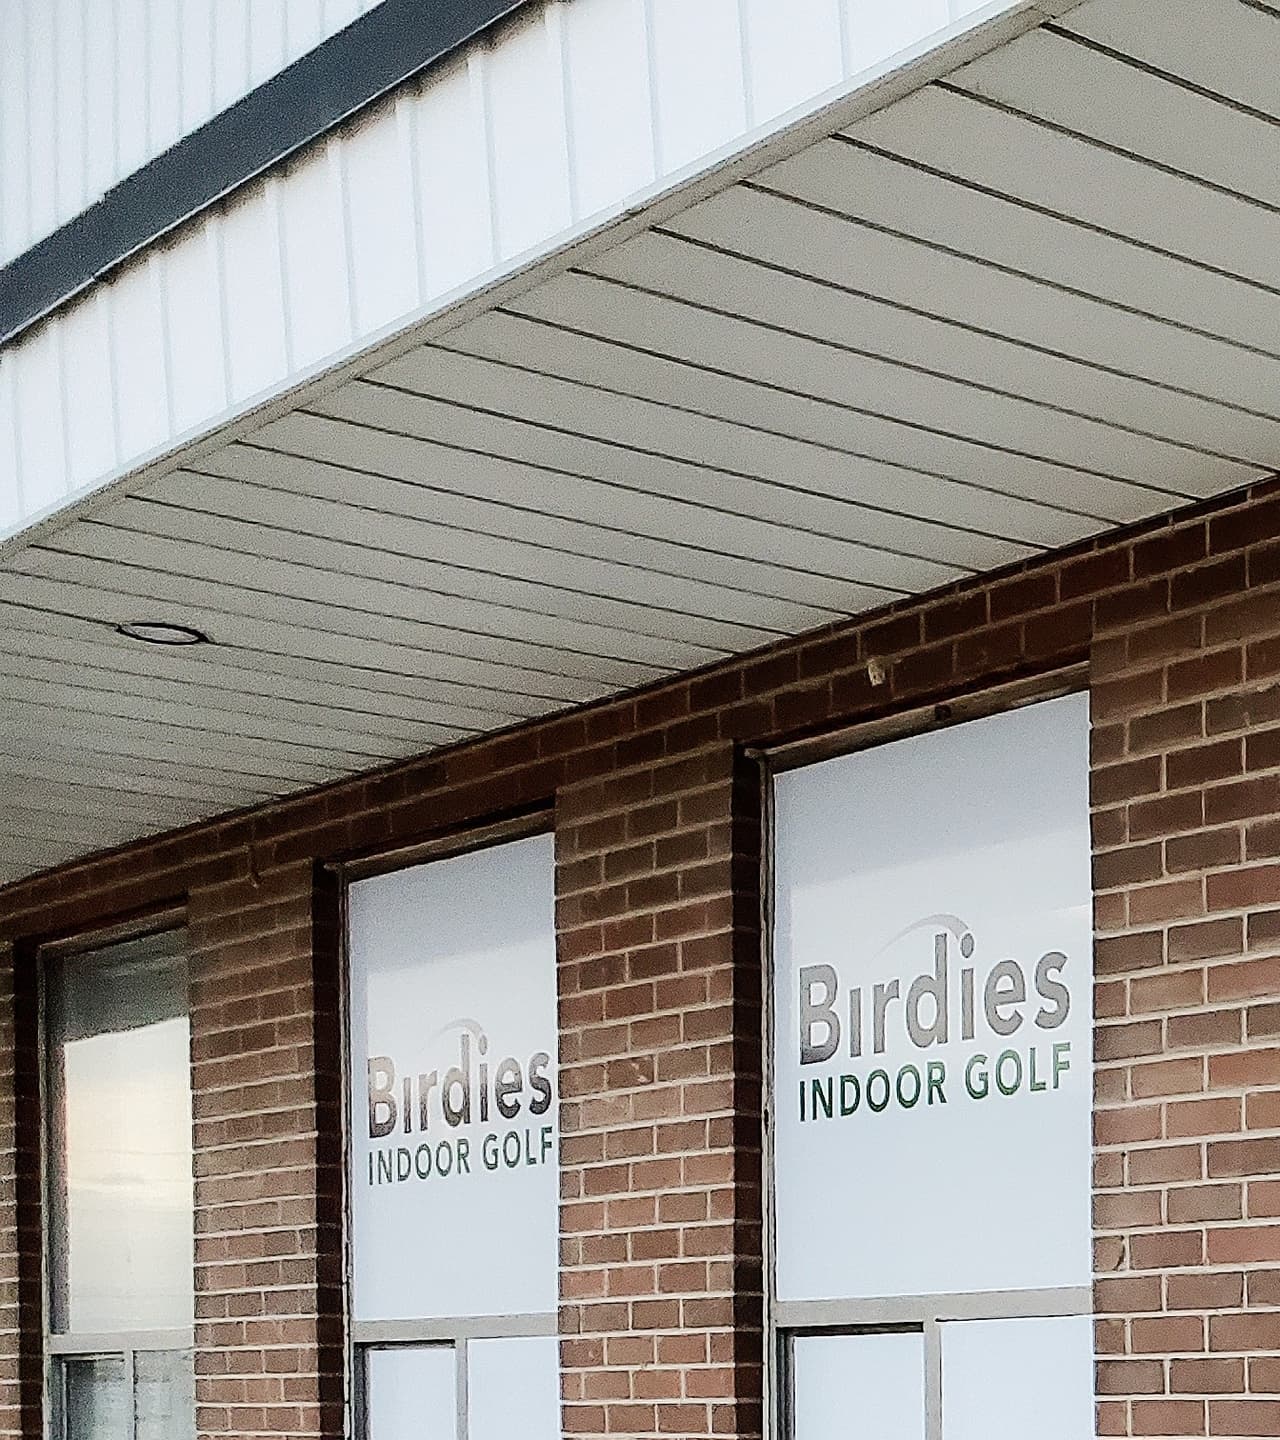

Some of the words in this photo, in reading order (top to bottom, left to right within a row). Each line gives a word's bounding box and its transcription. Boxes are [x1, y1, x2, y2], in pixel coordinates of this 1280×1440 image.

[799, 932, 1072, 1065] Birdies
[367, 1030, 553, 1139] Birdies
[799, 1063, 947, 1122] INDOOR
[964, 1042, 1072, 1101] GOLF
[367, 1140, 471, 1186] INDOOR
[482, 1125, 554, 1170] GOLF
